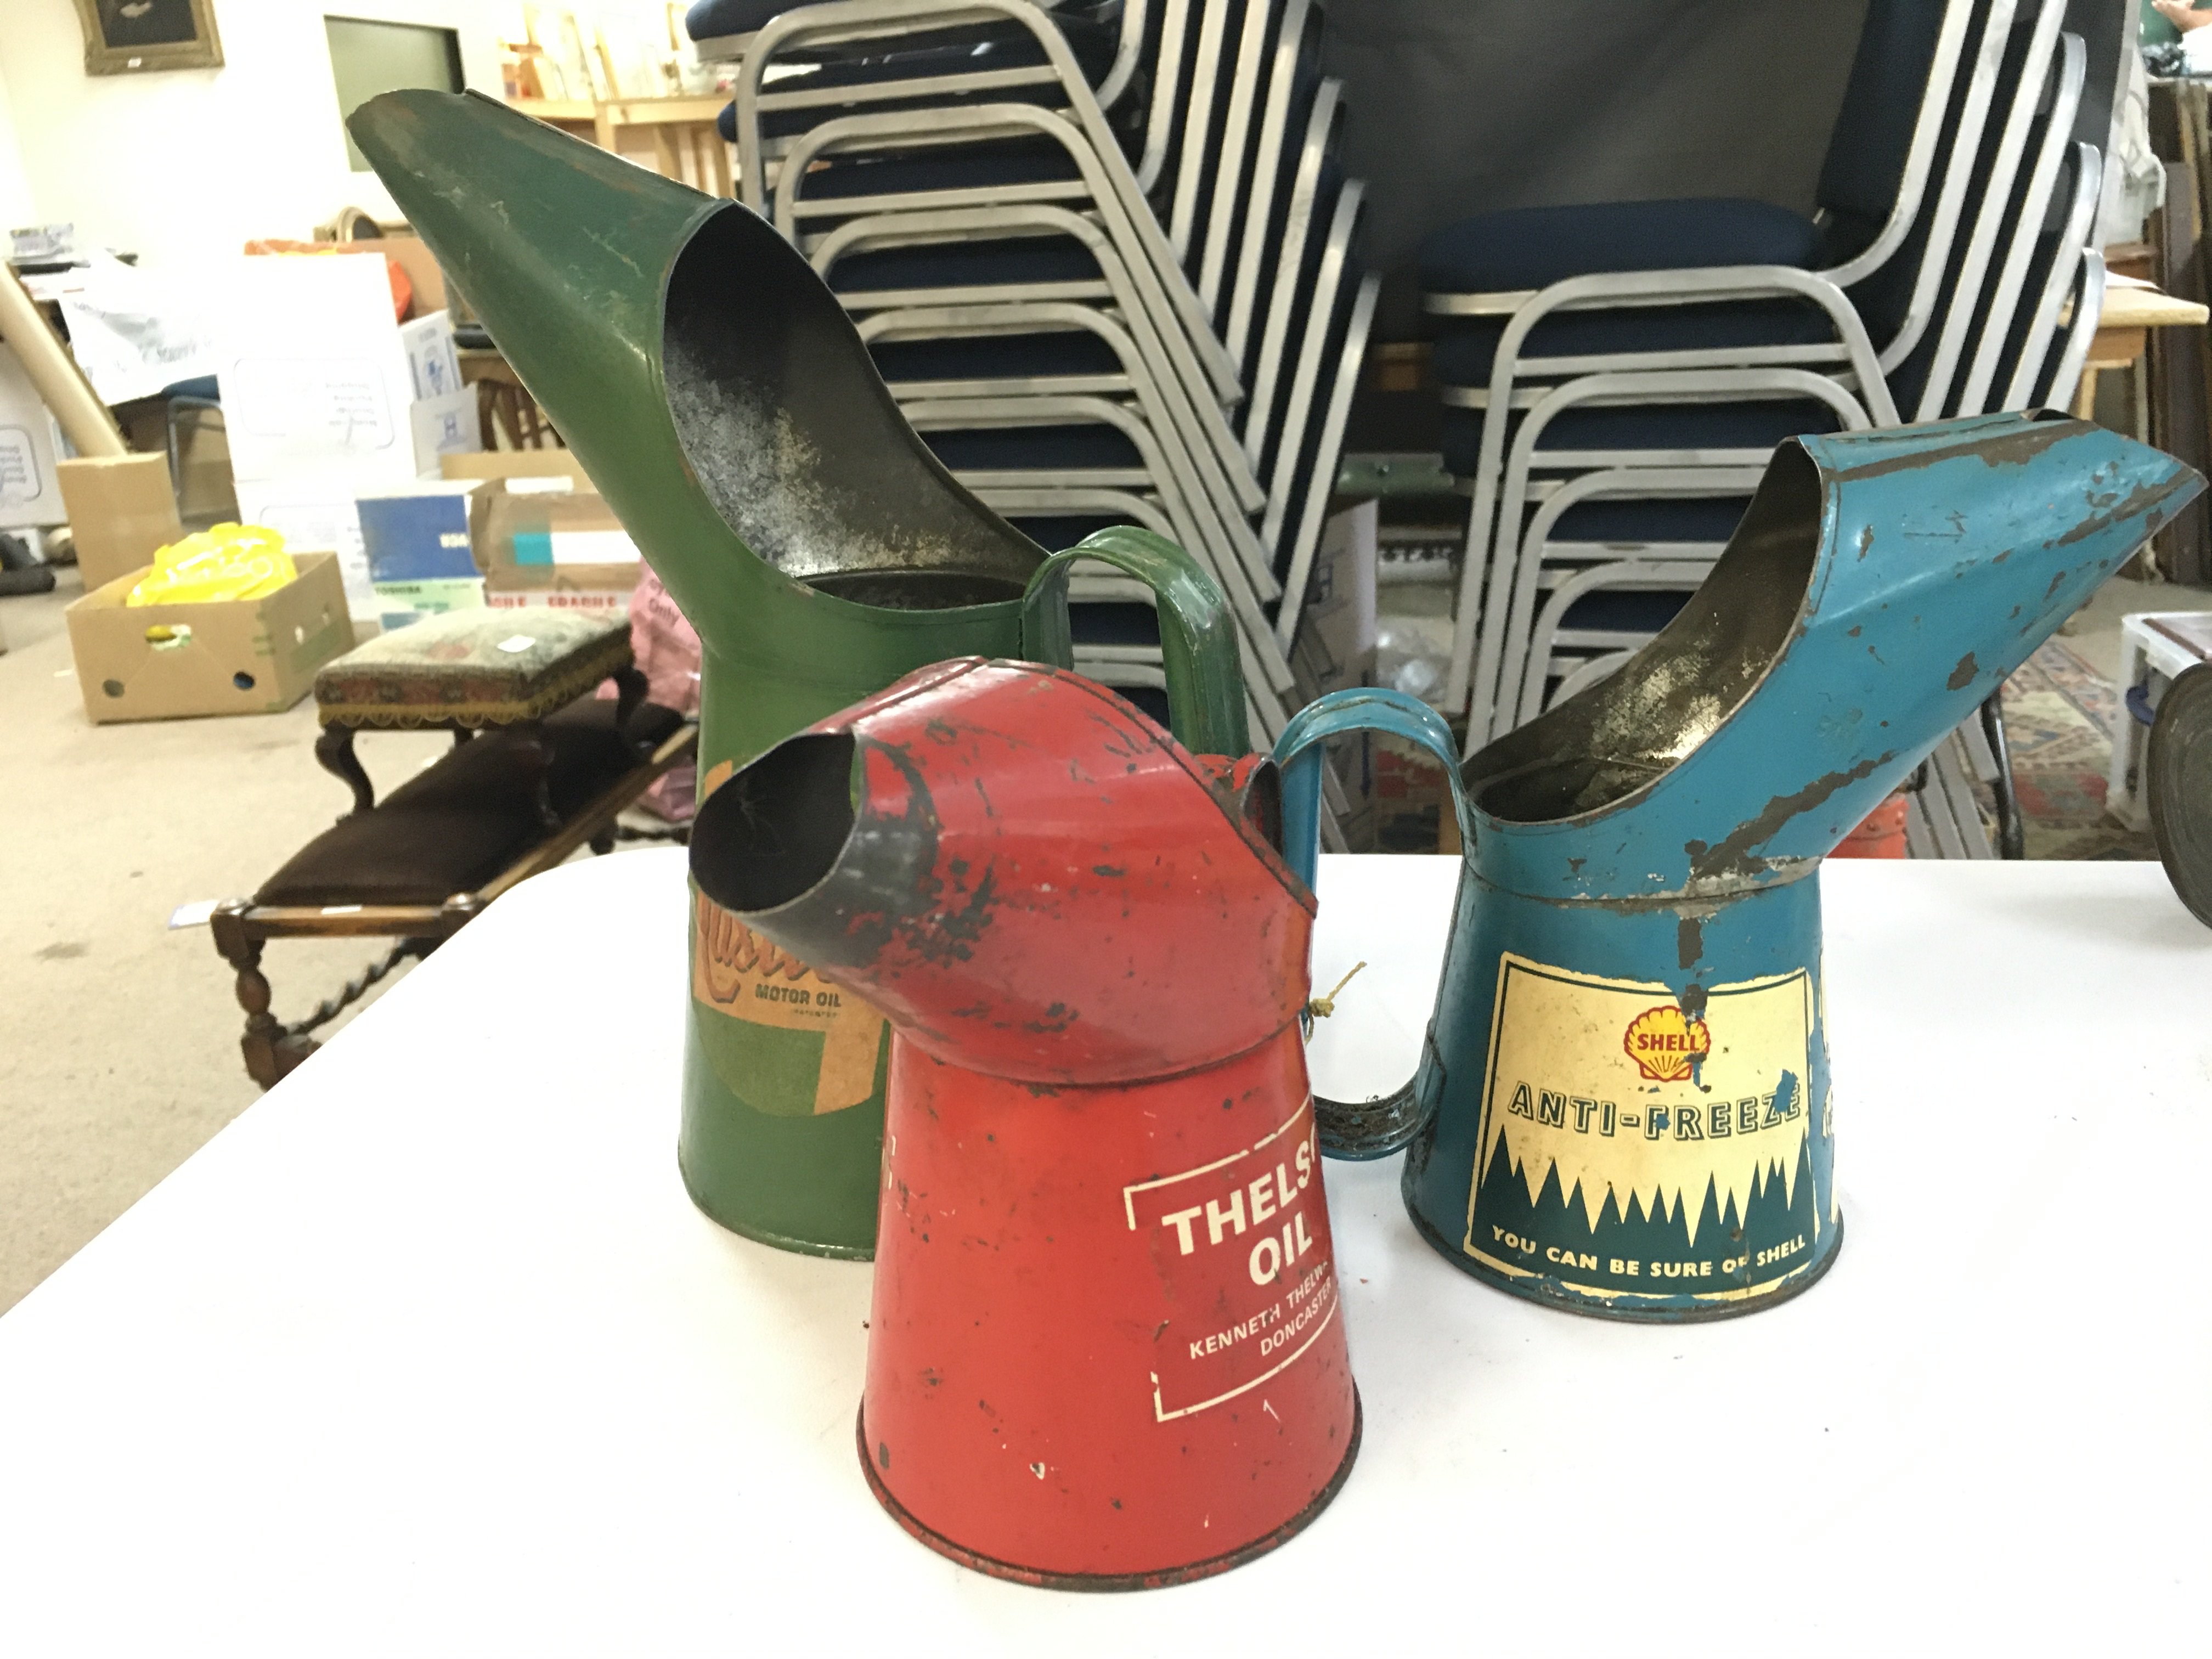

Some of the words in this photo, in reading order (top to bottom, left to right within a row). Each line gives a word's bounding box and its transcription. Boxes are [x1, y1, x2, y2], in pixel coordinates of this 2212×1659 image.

[755, 983, 810, 1005] MOTOR
[816, 991, 842, 1008] OIL
[1637, 1033, 1700, 1051] SHELL
[1508, 1081, 1801, 1141] ANTI-FREEZE
[1161, 1122, 1315, 1255] THELS
[1249, 1211, 1313, 1285] OIL
[1492, 1224, 1537, 1255] YOU
[1546, 1246, 1598, 1271] CAN
[1609, 1259, 1640, 1277] BE
[1650, 1261, 1712, 1277] SURE
[1756, 1234, 1807, 1267] SHELL
[1189, 1303, 1280, 1359] KENNETH
[1260, 1276, 1331, 1357] DONCASTER
